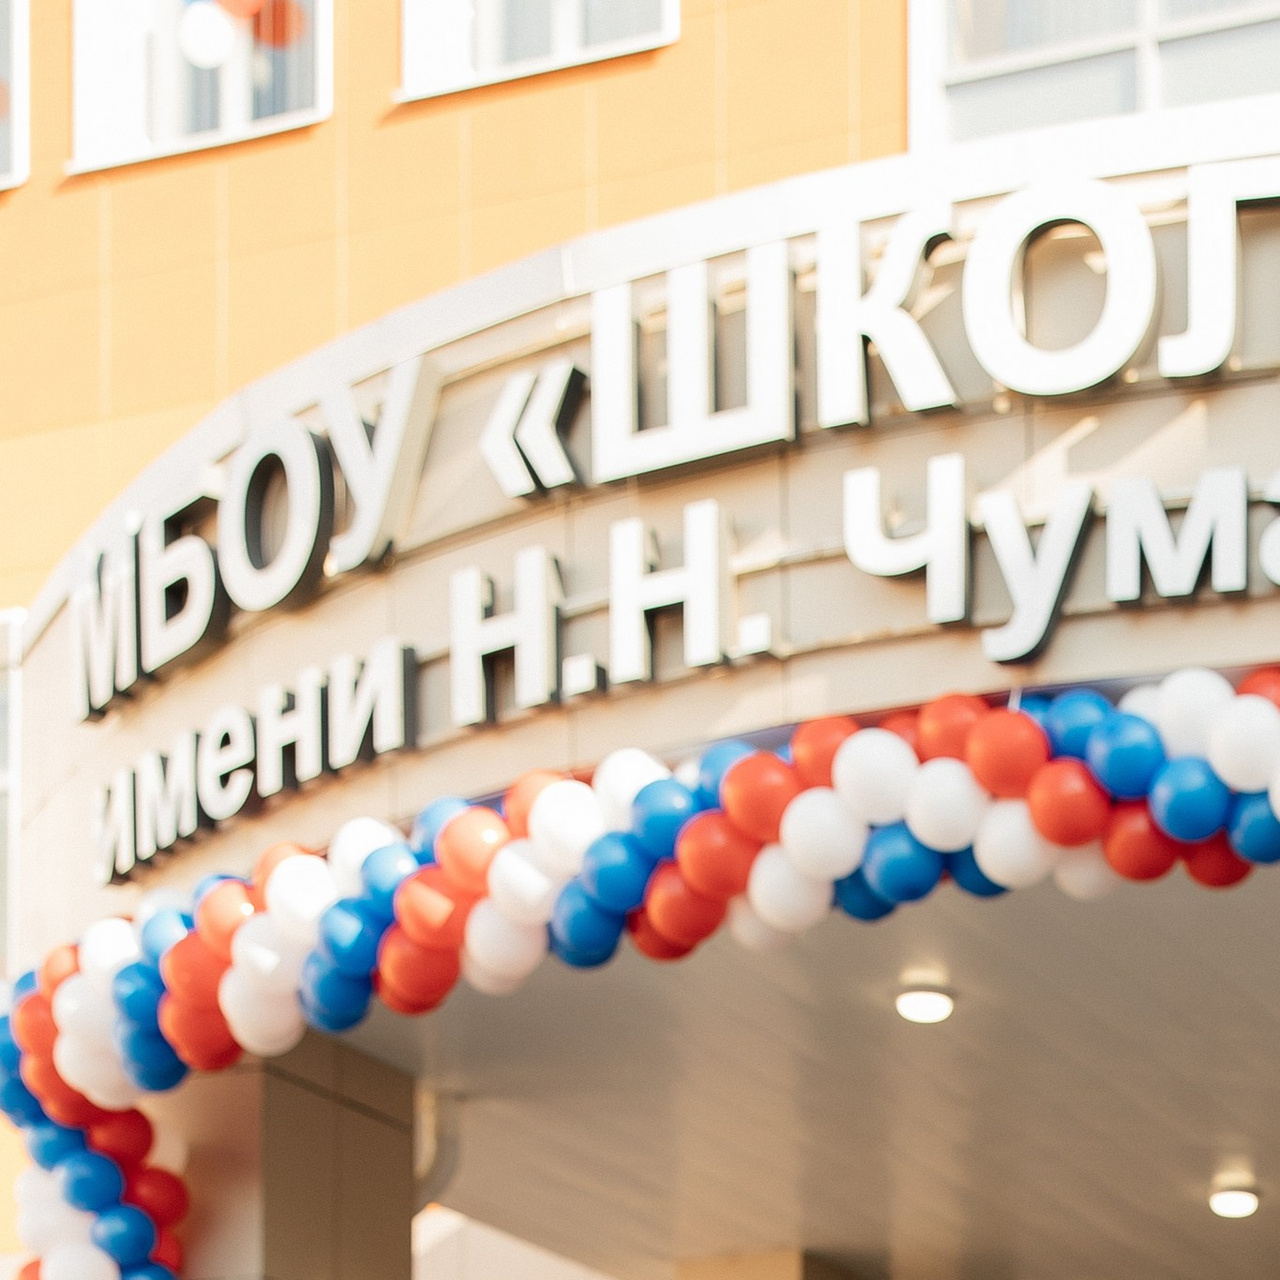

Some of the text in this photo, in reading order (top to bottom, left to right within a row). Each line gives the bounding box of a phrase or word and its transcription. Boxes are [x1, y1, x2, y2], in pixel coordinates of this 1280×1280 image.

[72, 353, 438, 720] МБОУ
[95, 638, 413, 886] имени
[450, 499, 773, 727] Н.Н.
